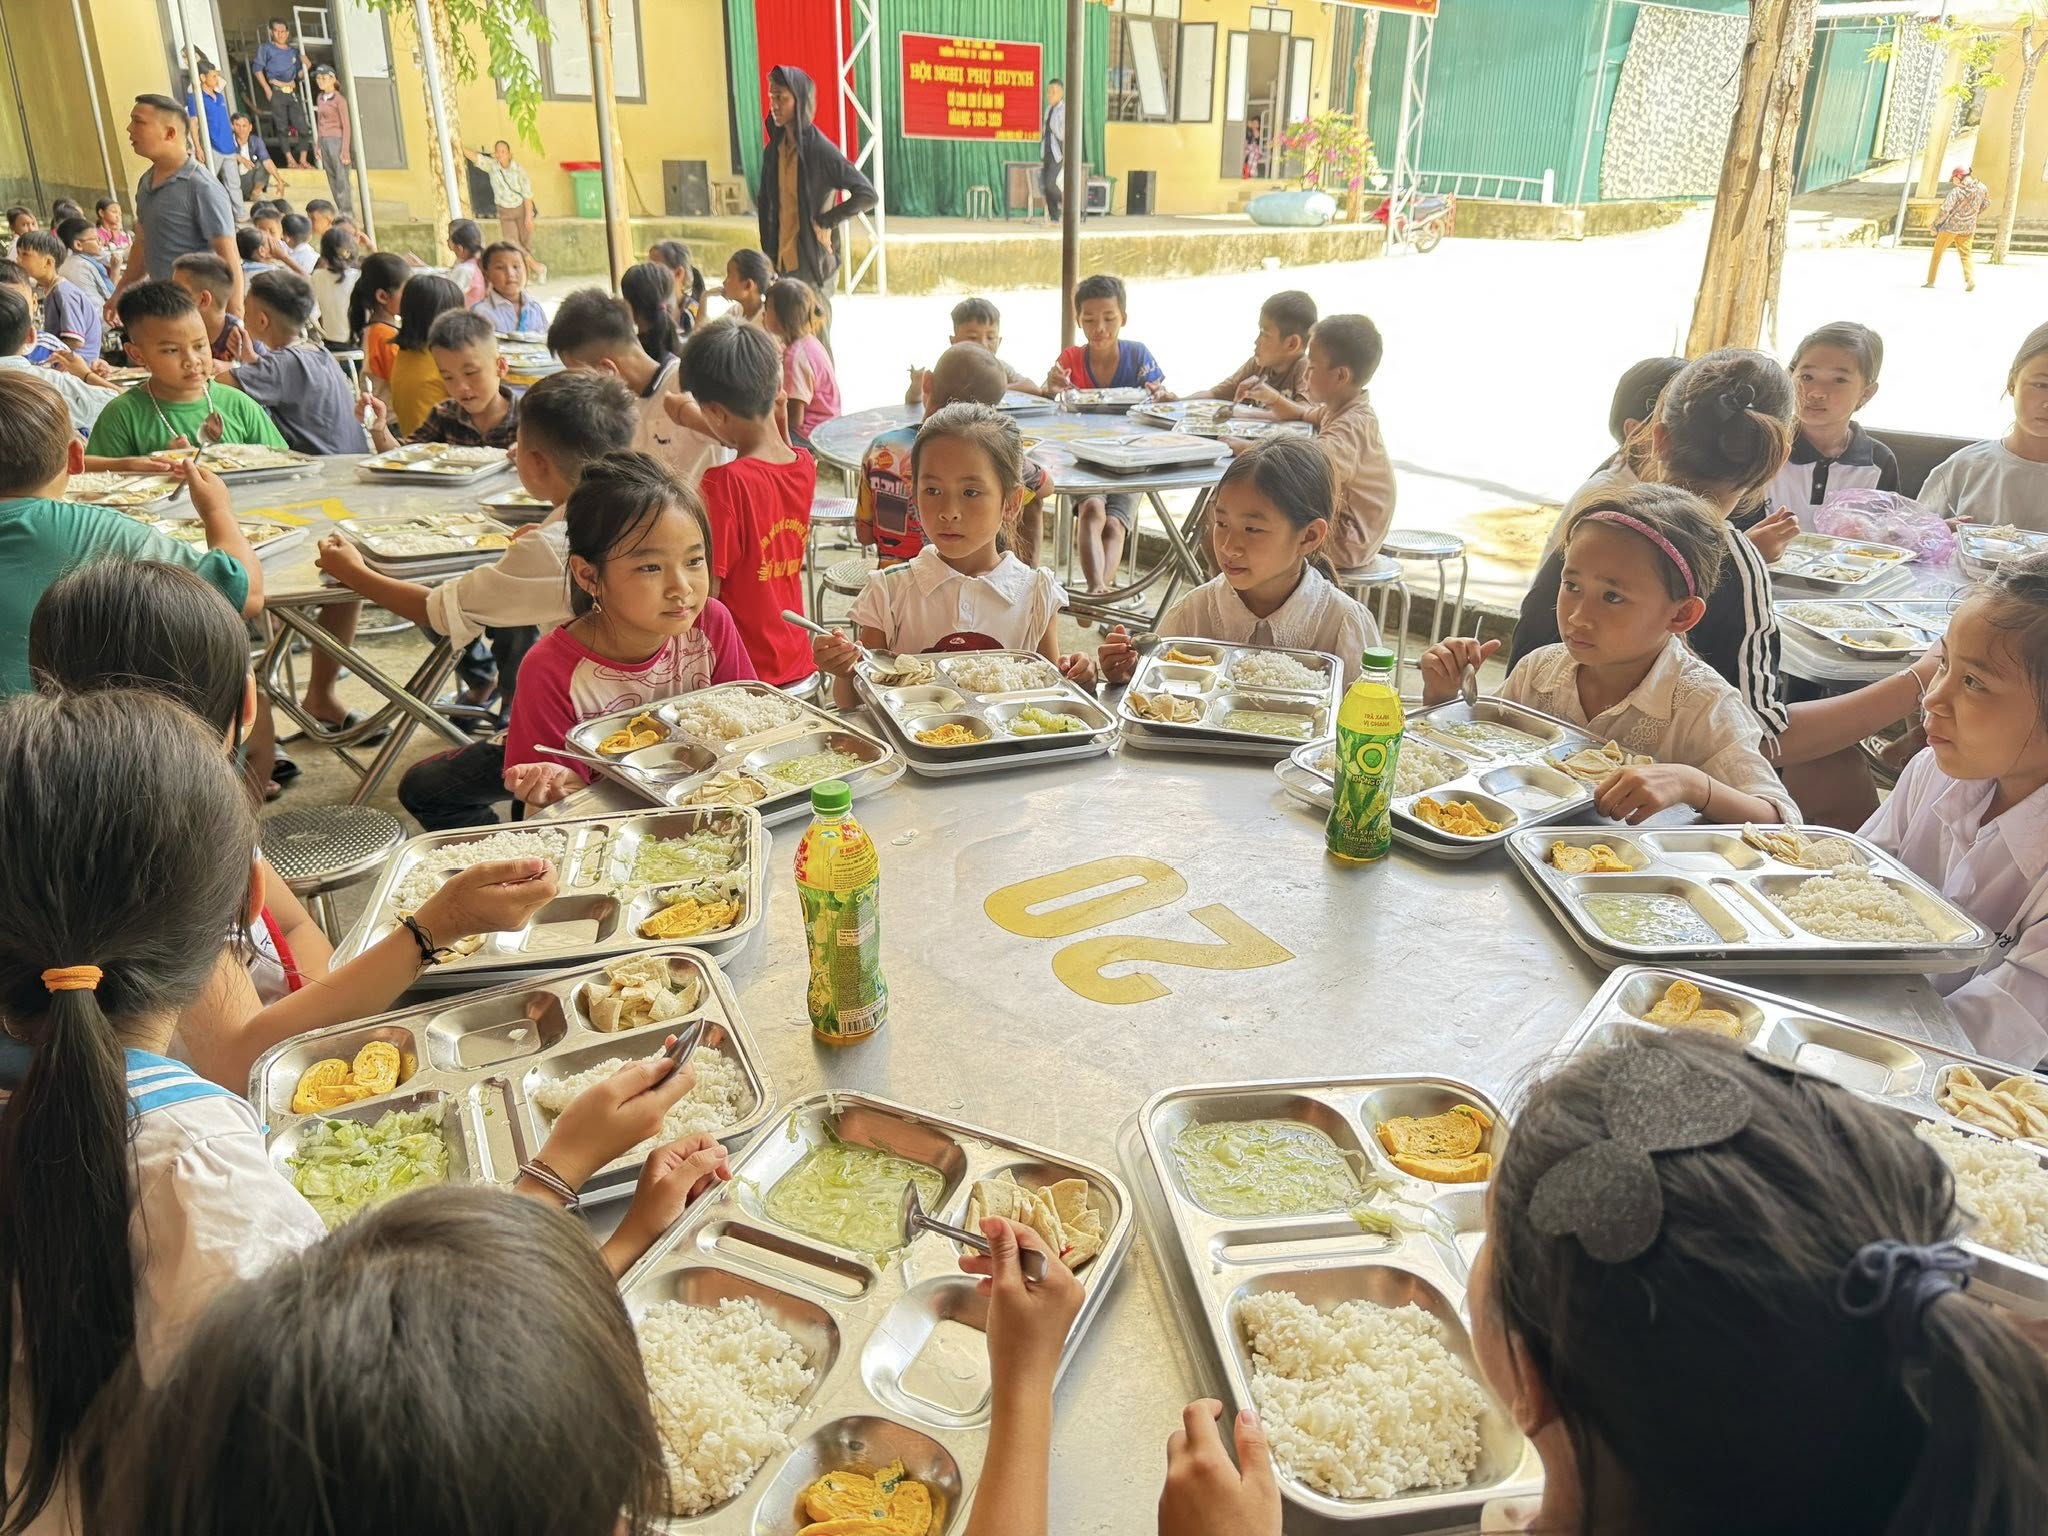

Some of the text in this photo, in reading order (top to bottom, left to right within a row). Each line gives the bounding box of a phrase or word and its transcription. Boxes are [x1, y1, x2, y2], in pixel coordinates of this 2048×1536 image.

[909, 60, 932, 84] HỘI
[933, 64, 964, 86] NGHỊ
[966, 67, 992, 88] PHỤ
